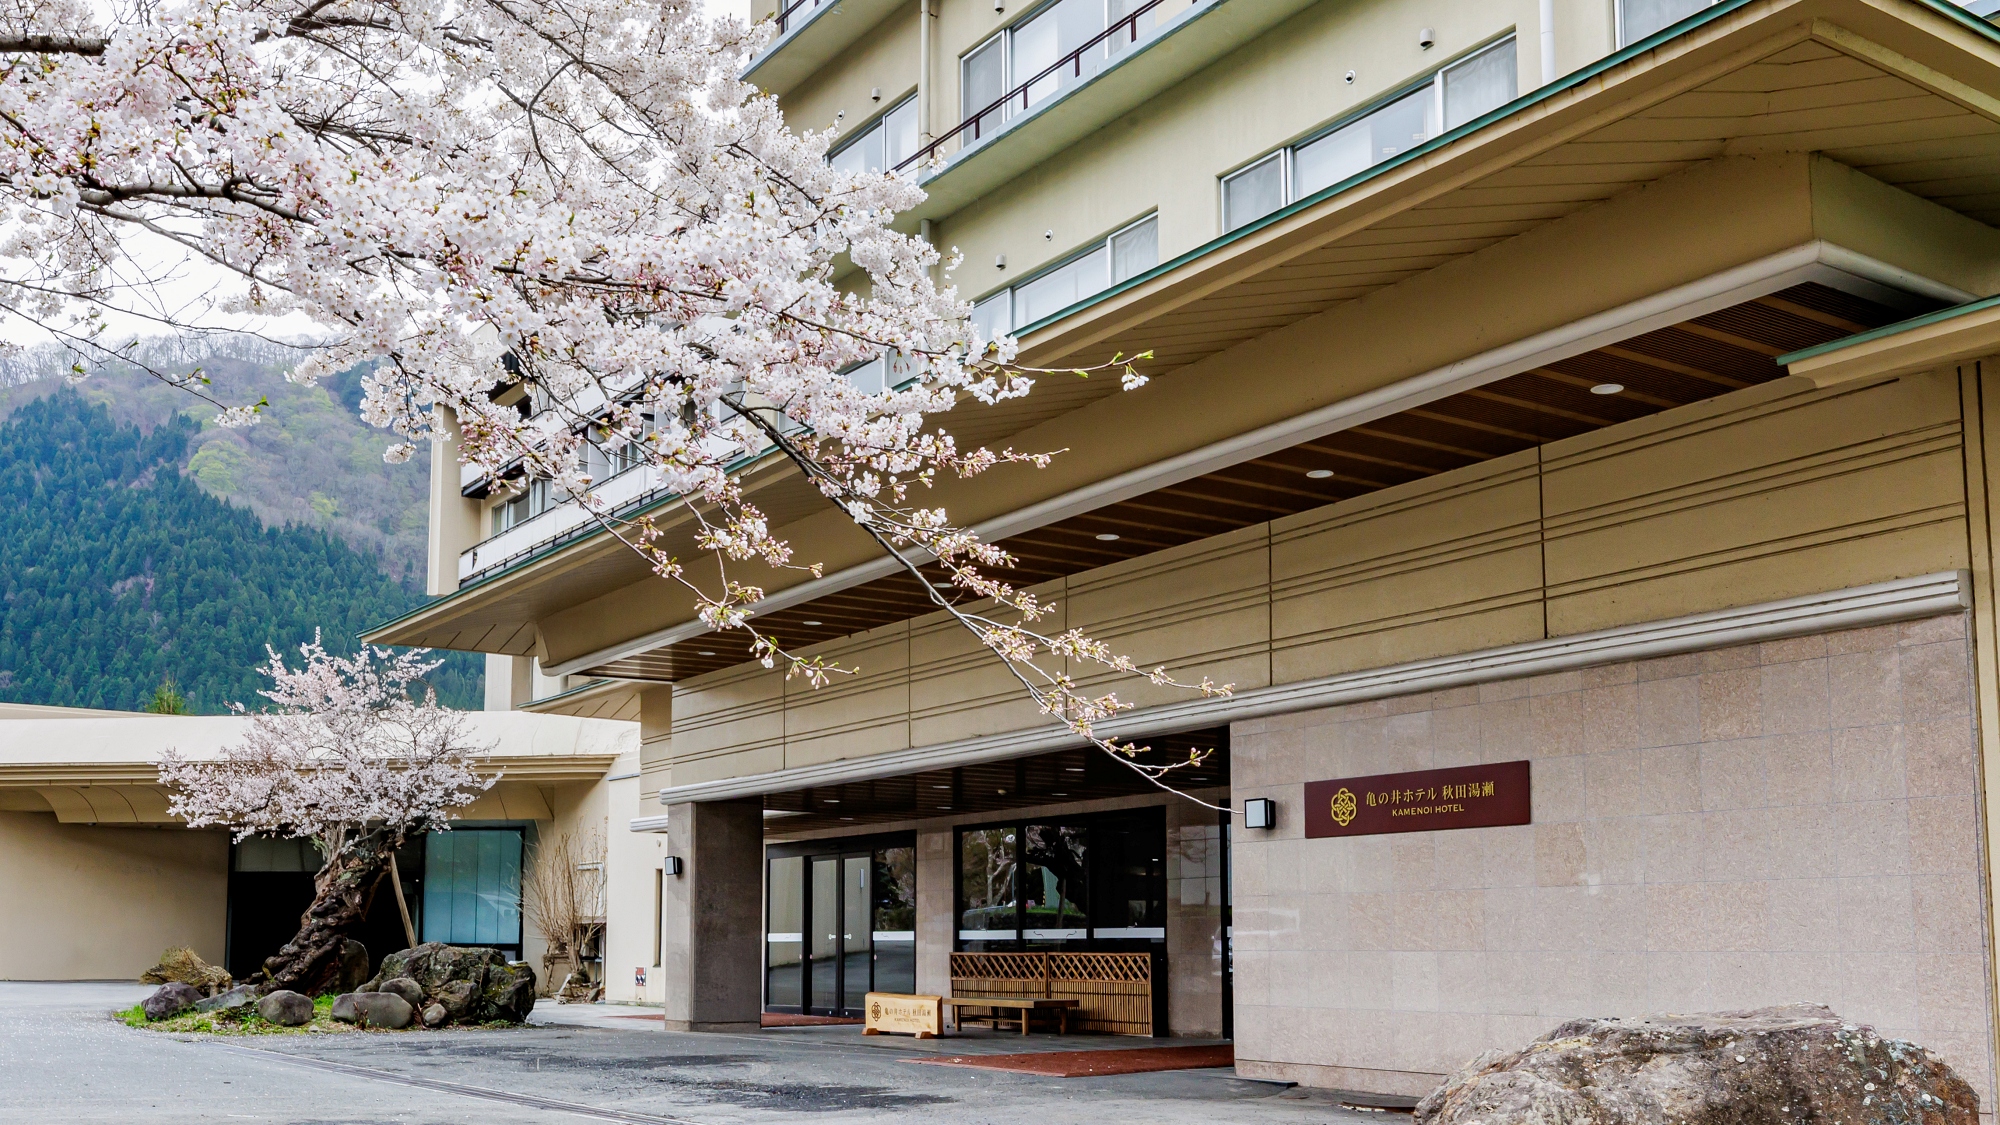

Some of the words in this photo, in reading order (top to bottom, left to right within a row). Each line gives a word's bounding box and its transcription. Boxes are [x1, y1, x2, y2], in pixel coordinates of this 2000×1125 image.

[1366, 787, 1438, 807] 亀の井ホテル
[1442, 781, 1495, 800] 秋田湯瀬
[1392, 806, 1433, 817] KAMENOI
[1435, 804, 1465, 813] HOTEL
